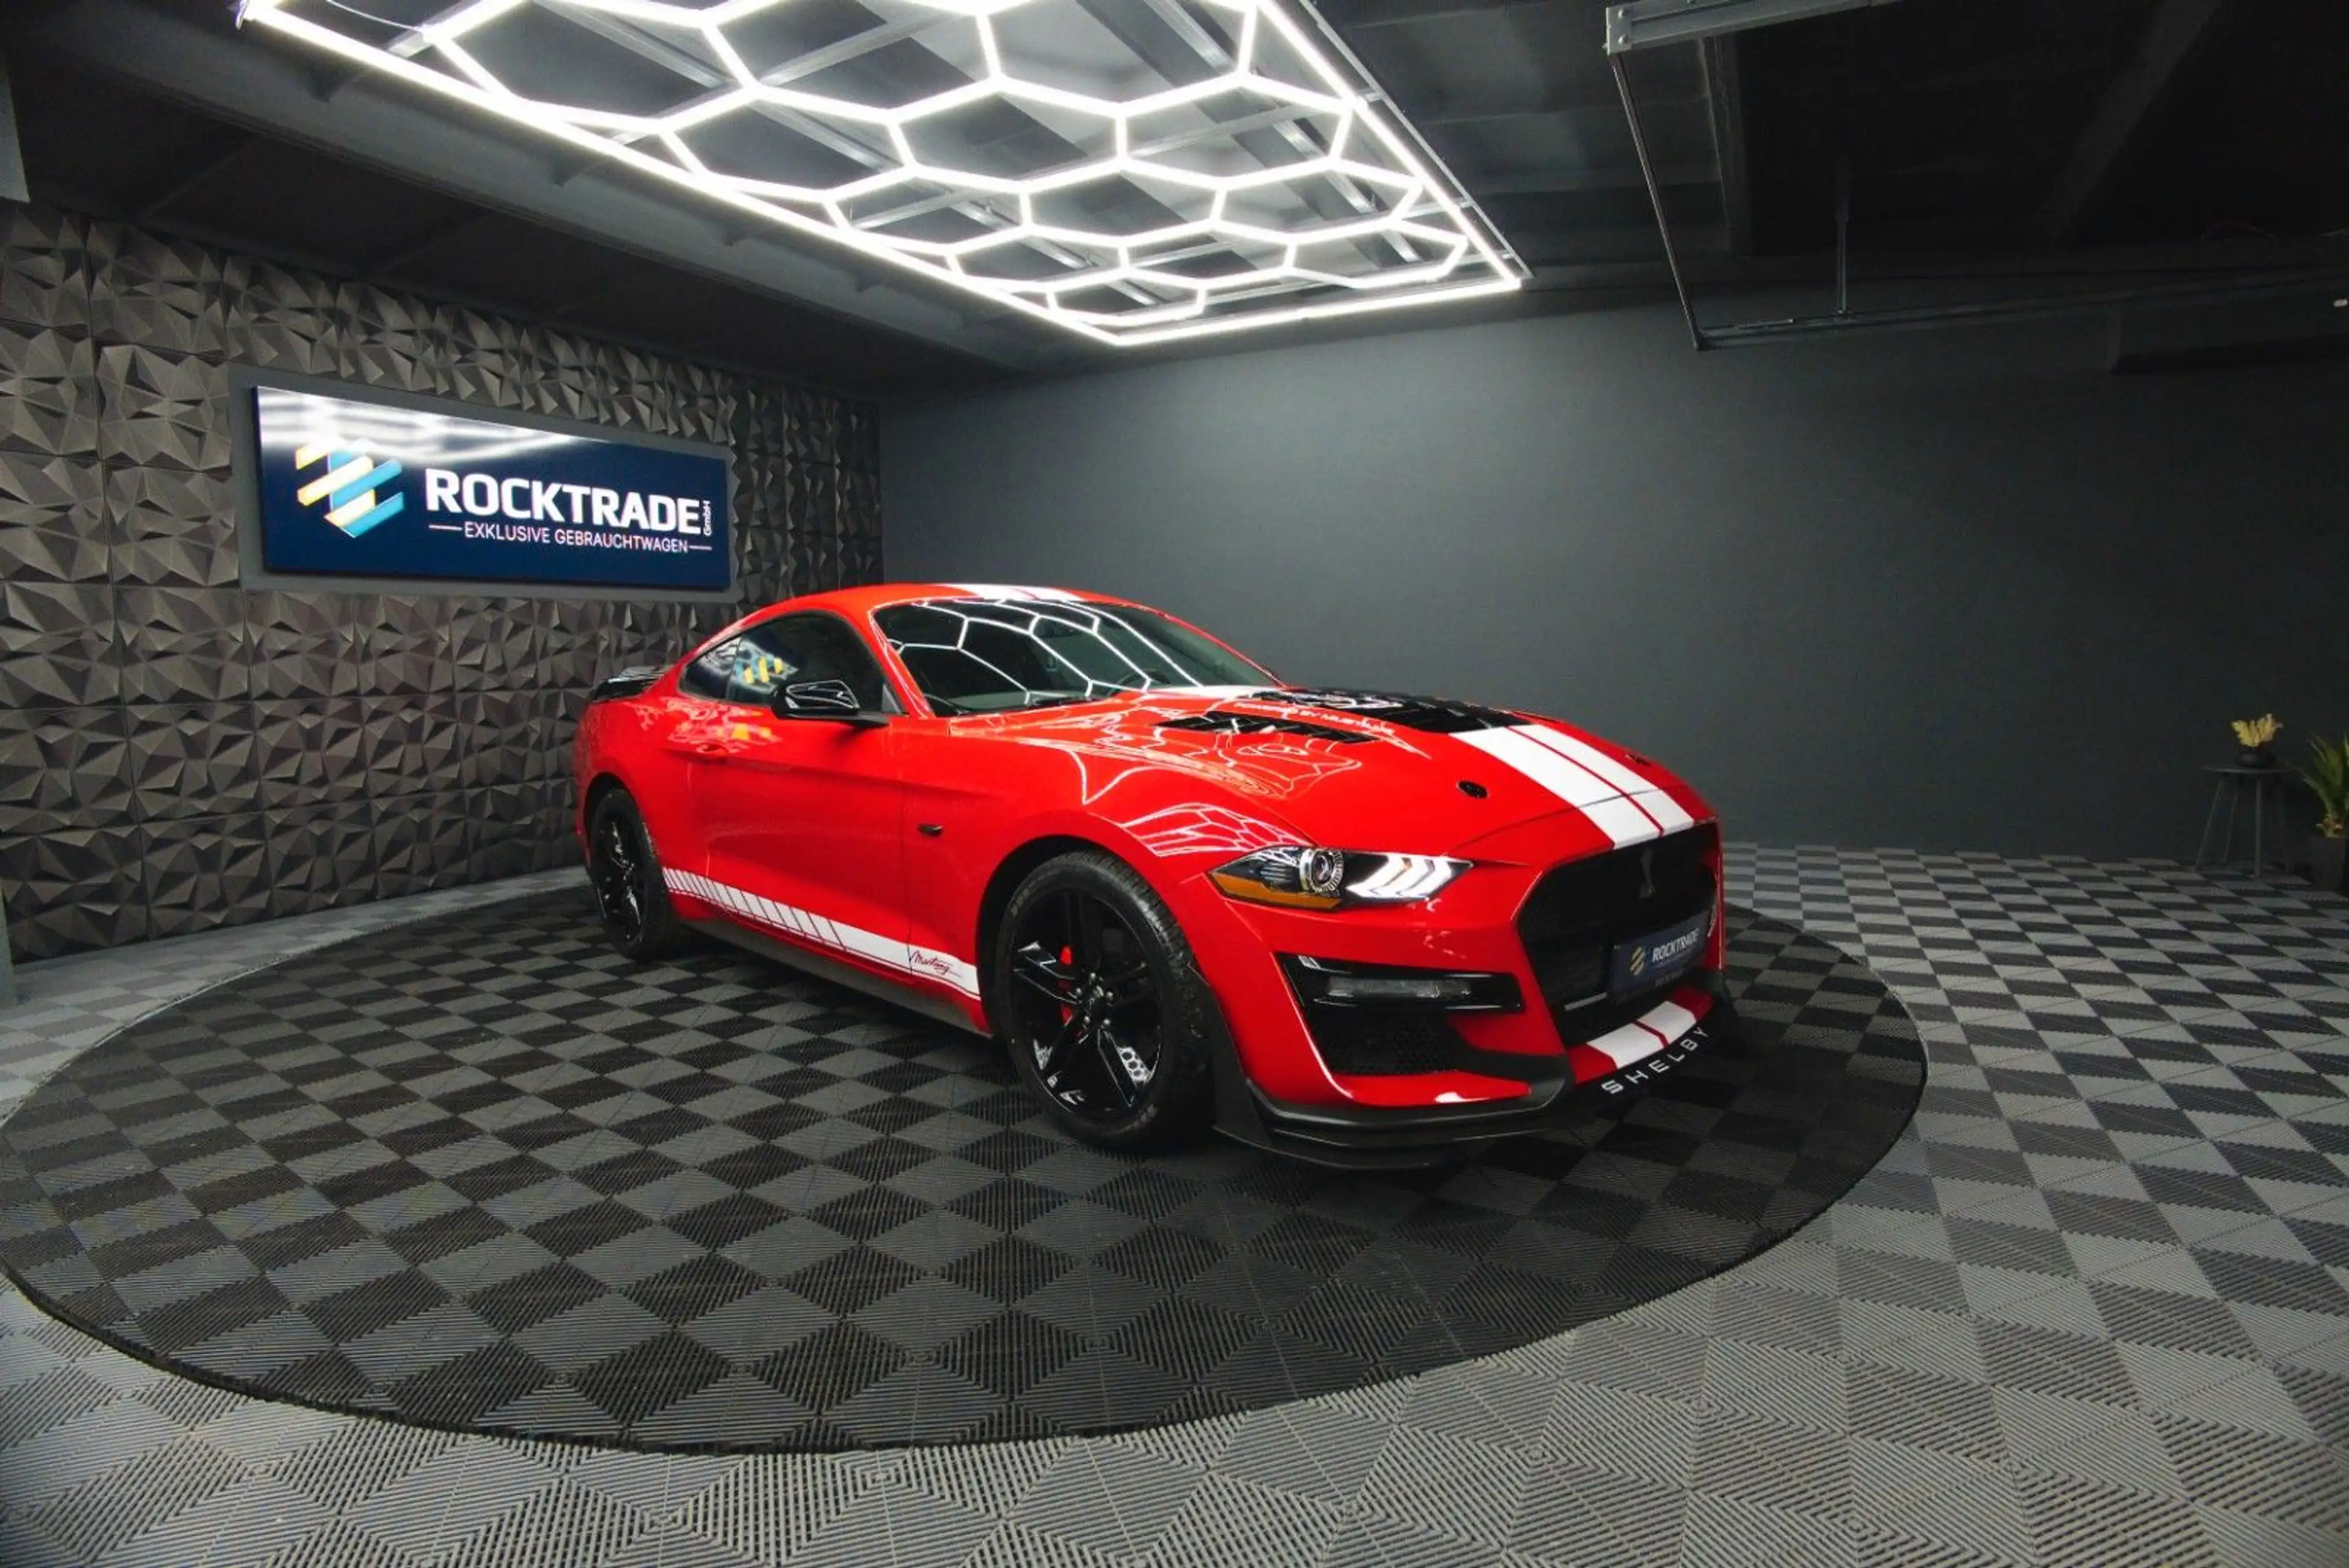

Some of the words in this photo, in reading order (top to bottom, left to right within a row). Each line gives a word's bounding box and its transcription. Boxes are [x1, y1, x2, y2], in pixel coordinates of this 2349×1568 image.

[424, 467, 702, 535] ROCKTRADE
[702, 499, 713, 537] GmbH
[464, 520, 551, 544] EXKLUSIVE
[554, 527, 689, 554] GEBRAUCHTWAGEN
[1600, 1026, 1709, 1094] SHELBY
